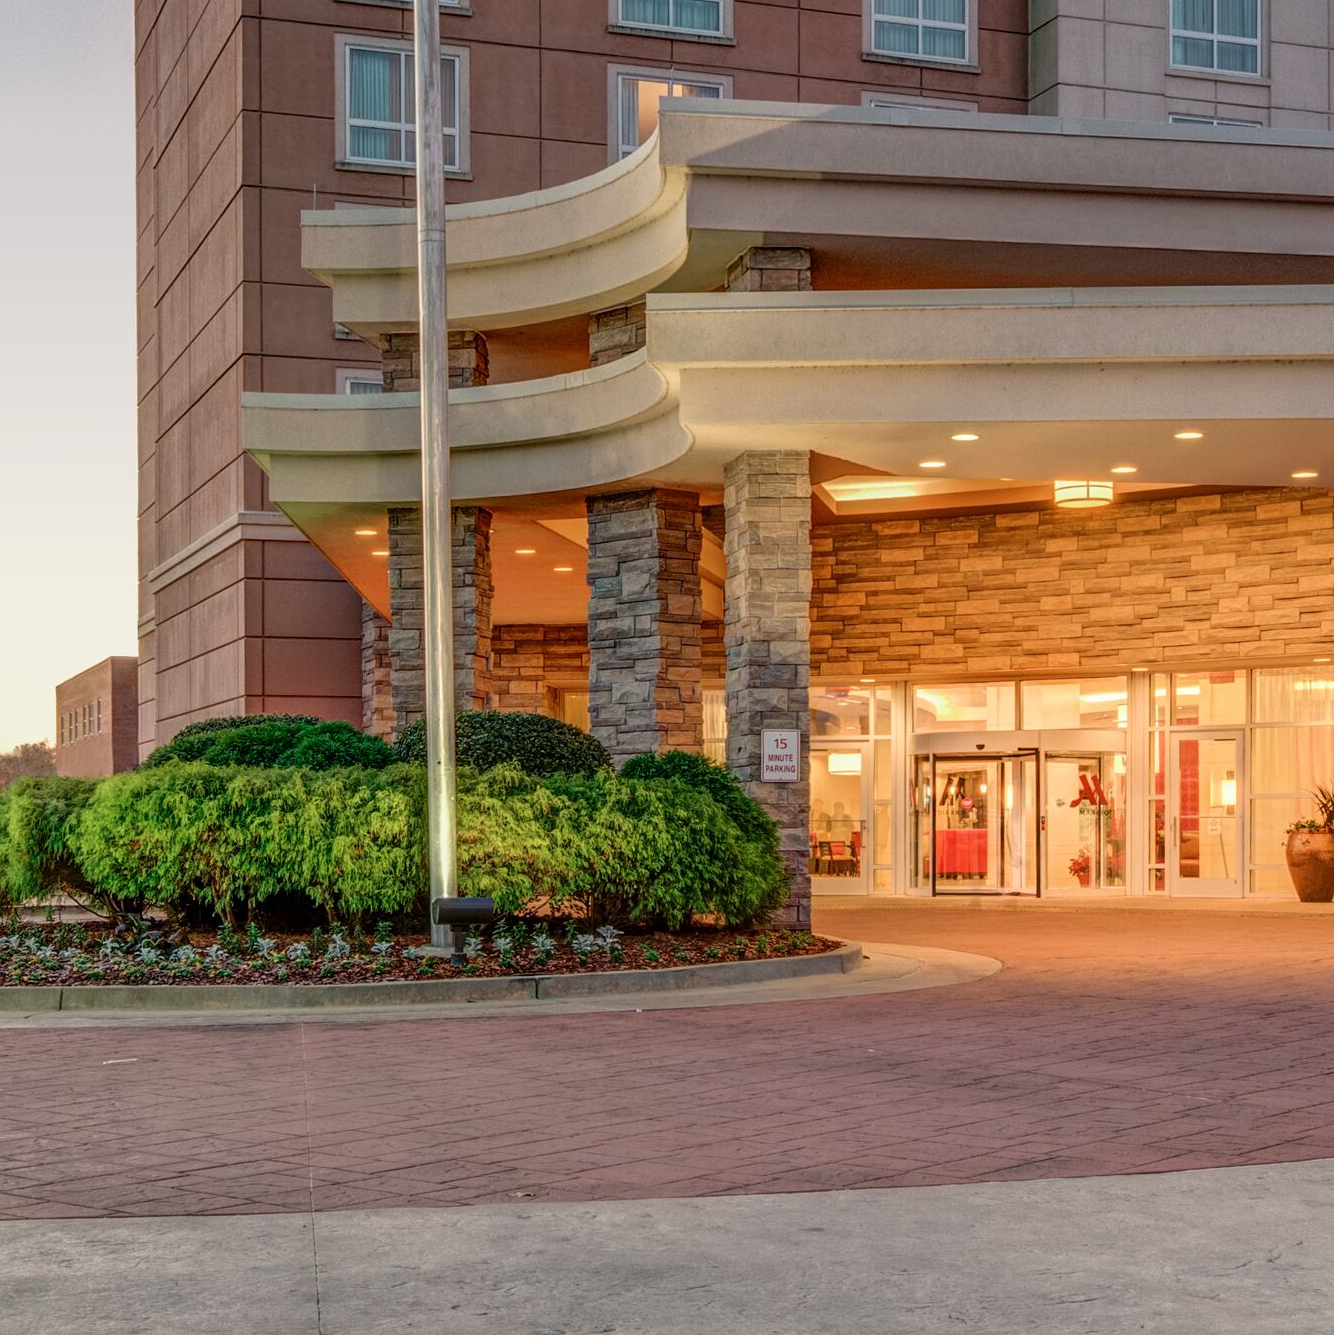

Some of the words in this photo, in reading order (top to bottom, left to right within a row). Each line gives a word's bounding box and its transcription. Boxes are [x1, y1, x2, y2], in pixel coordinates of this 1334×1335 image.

[773, 738, 788, 750] 15
[767, 754, 794, 762] MINUTE
[765, 765, 796, 773] PARKING
